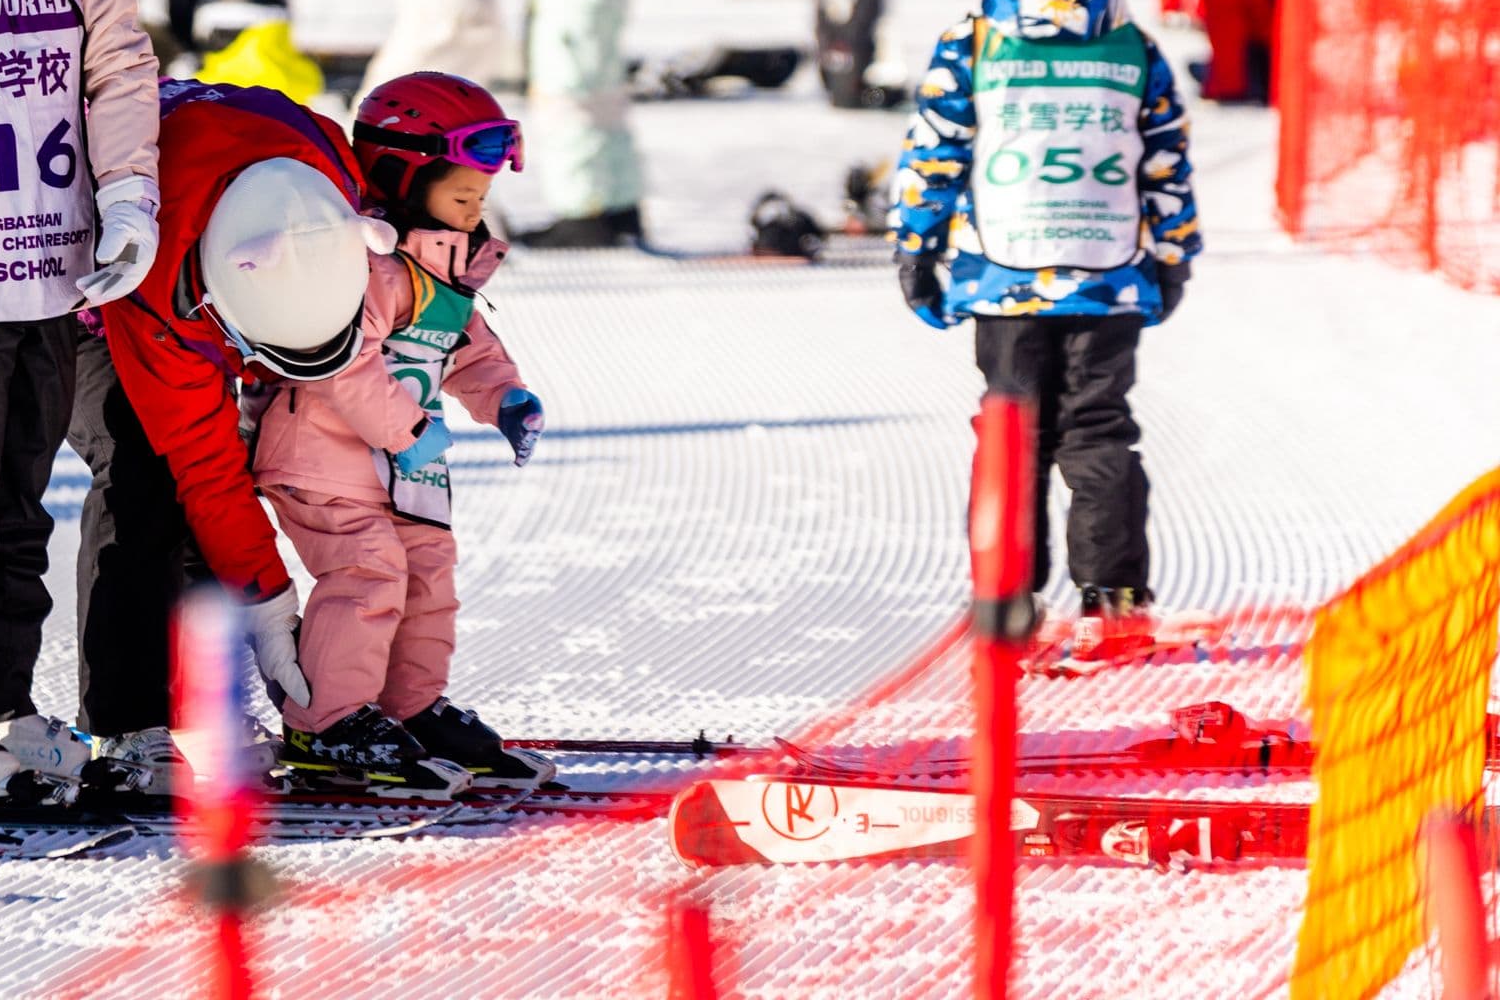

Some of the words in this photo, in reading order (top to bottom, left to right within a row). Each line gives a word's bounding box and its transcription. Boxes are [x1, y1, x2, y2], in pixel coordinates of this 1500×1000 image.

[983, 60, 1047, 80] WILD
[1052, 60, 1142, 86] WORLD
[986, 148, 1130, 186] 056
[2, 235, 45, 252] CHIN
[1043, 227, 1117, 242] SCHOOL
[401, 470, 449, 489] SCHO
